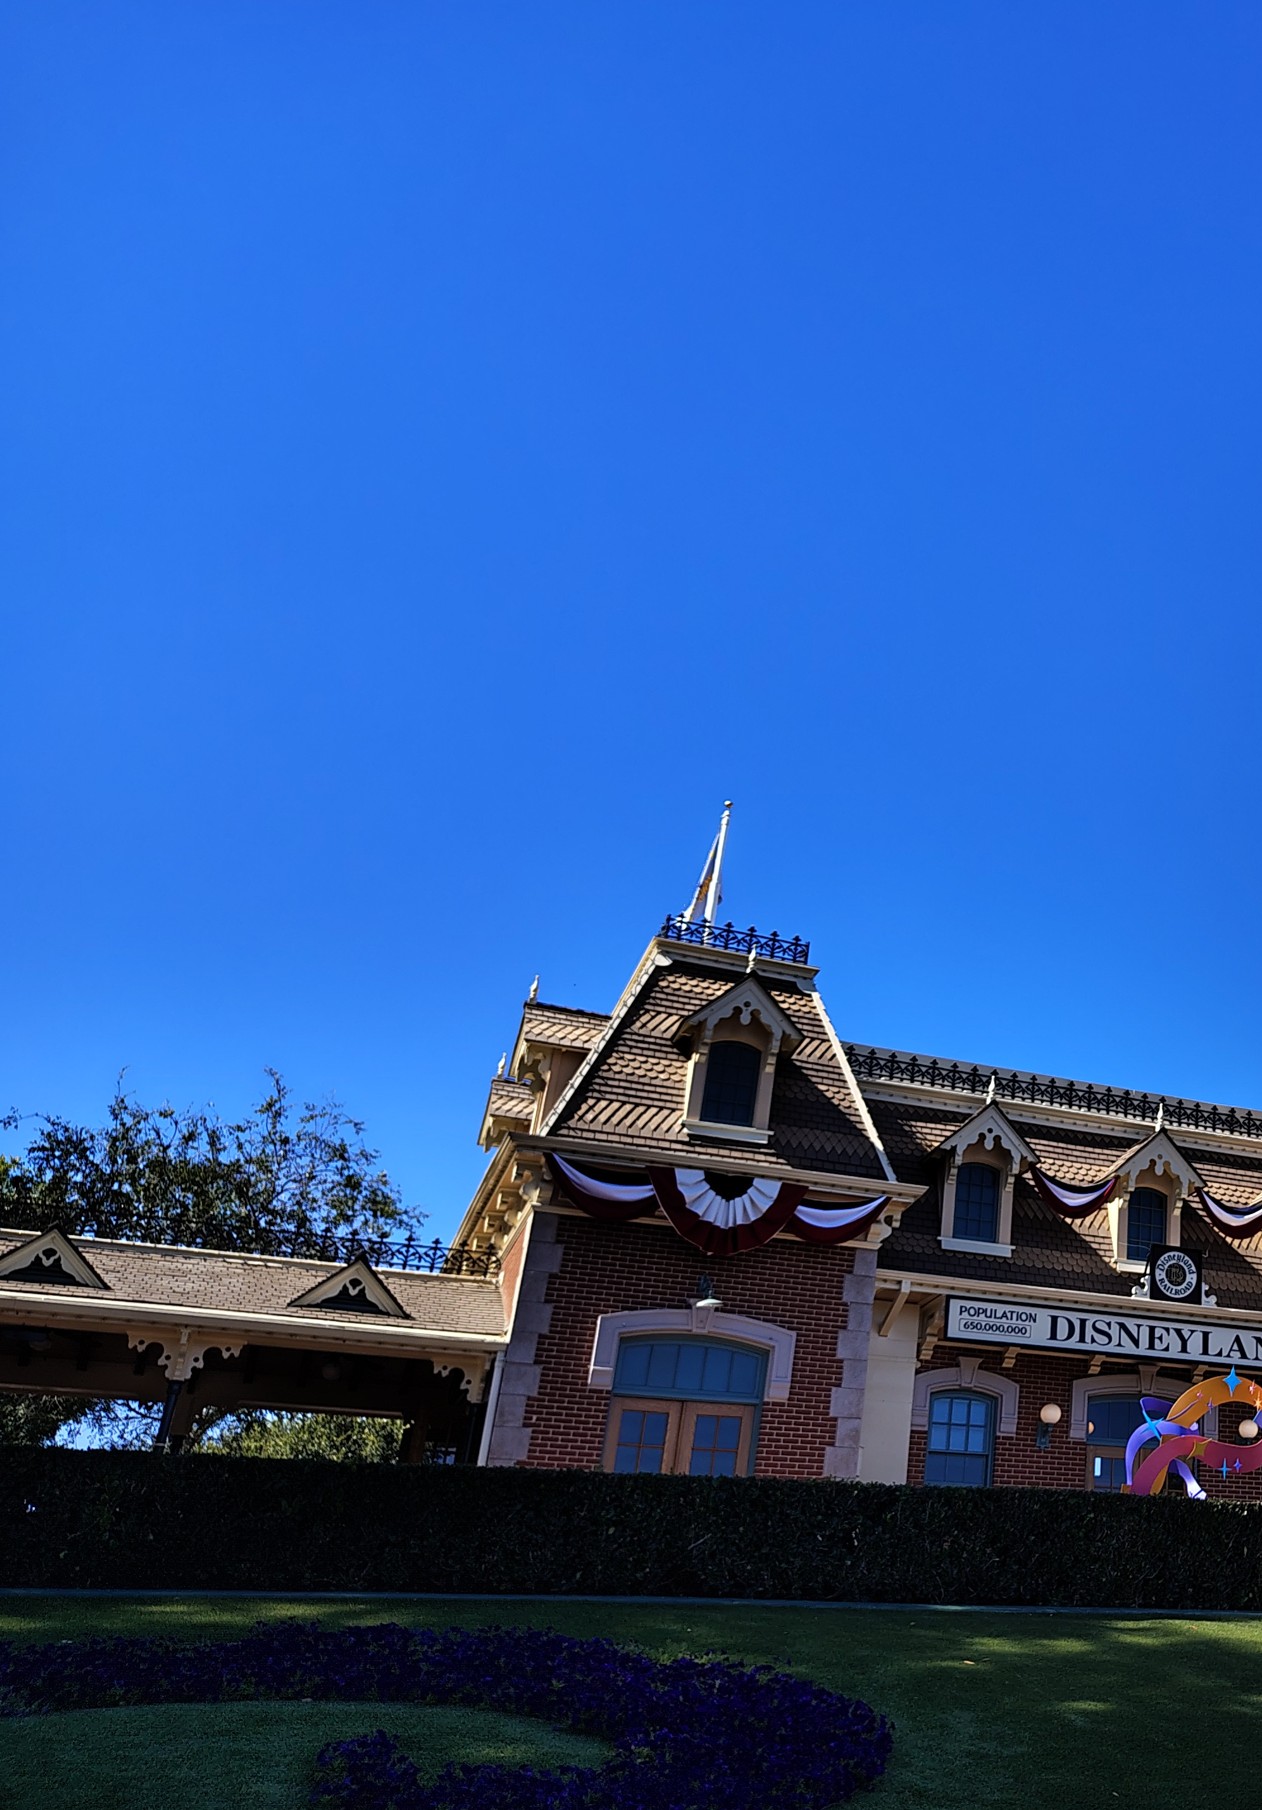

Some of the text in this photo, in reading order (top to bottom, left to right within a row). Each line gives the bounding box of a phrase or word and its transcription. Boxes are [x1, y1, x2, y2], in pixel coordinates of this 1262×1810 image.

[1157, 1254, 1197, 1275] Disneyland
[1158, 1278, 1194, 1296] RAILROAD
[959, 1305, 1037, 1324] POPULATION
[963, 1320, 1028, 1336] 650,000,000
